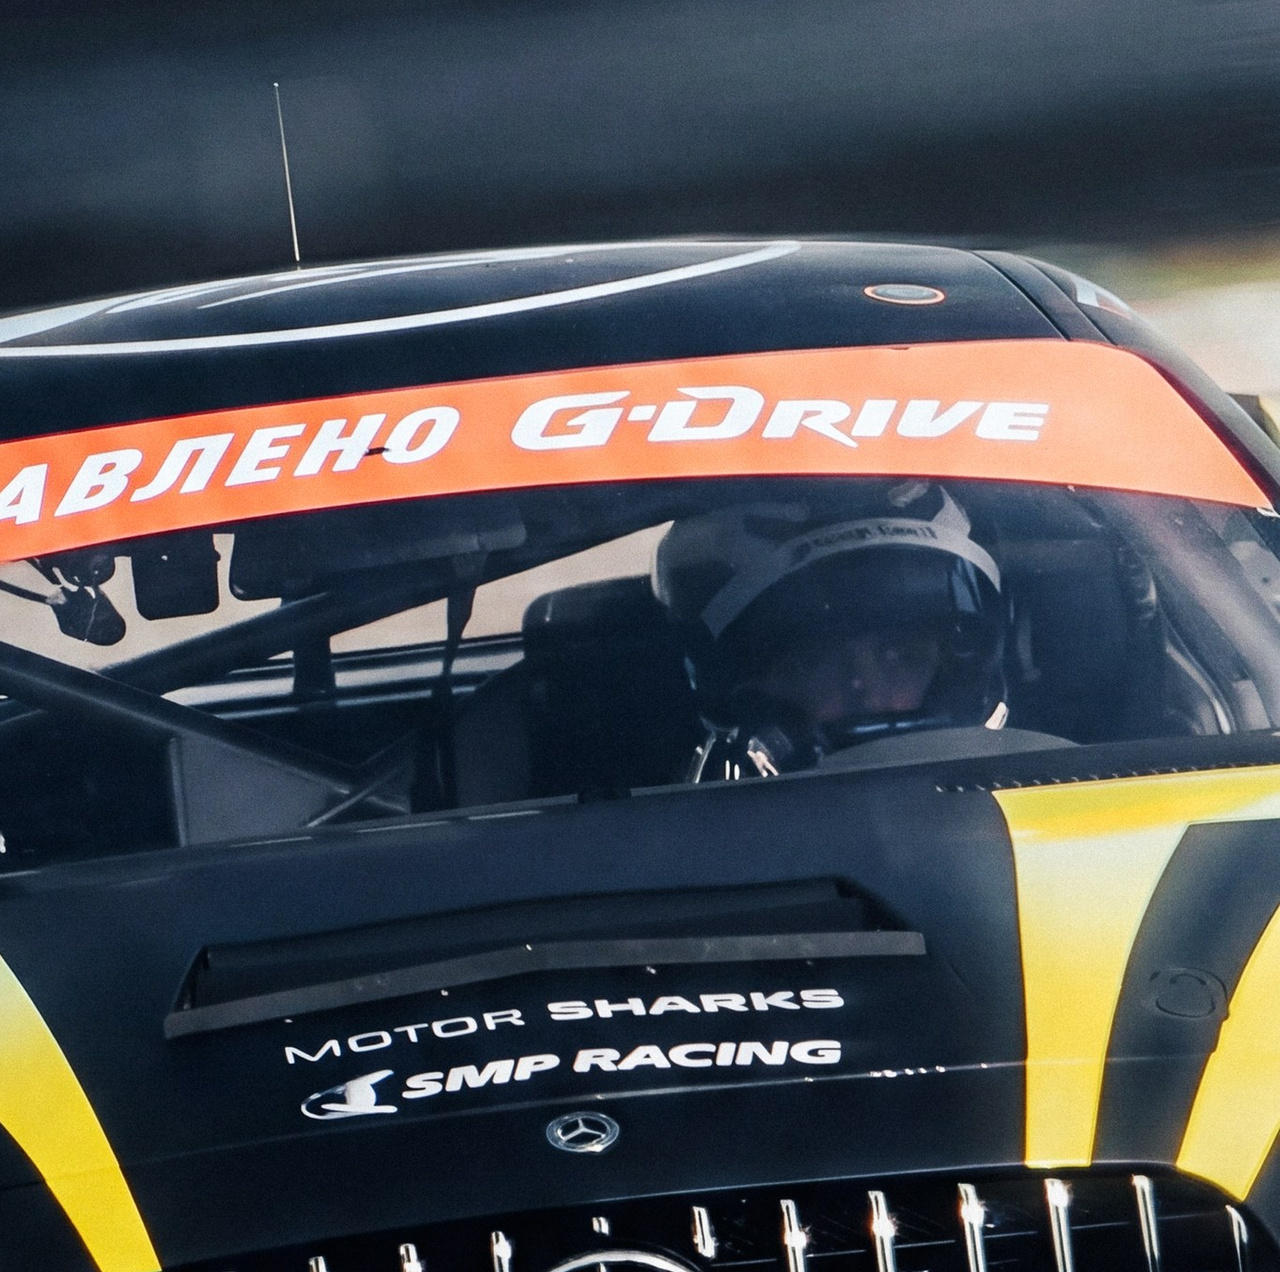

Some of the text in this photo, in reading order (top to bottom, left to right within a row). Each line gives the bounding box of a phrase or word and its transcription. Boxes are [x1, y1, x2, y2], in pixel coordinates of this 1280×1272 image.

[284, 988, 845, 1065] MOTOR SHARKS
[401, 1039, 842, 1100] SMP RACING
